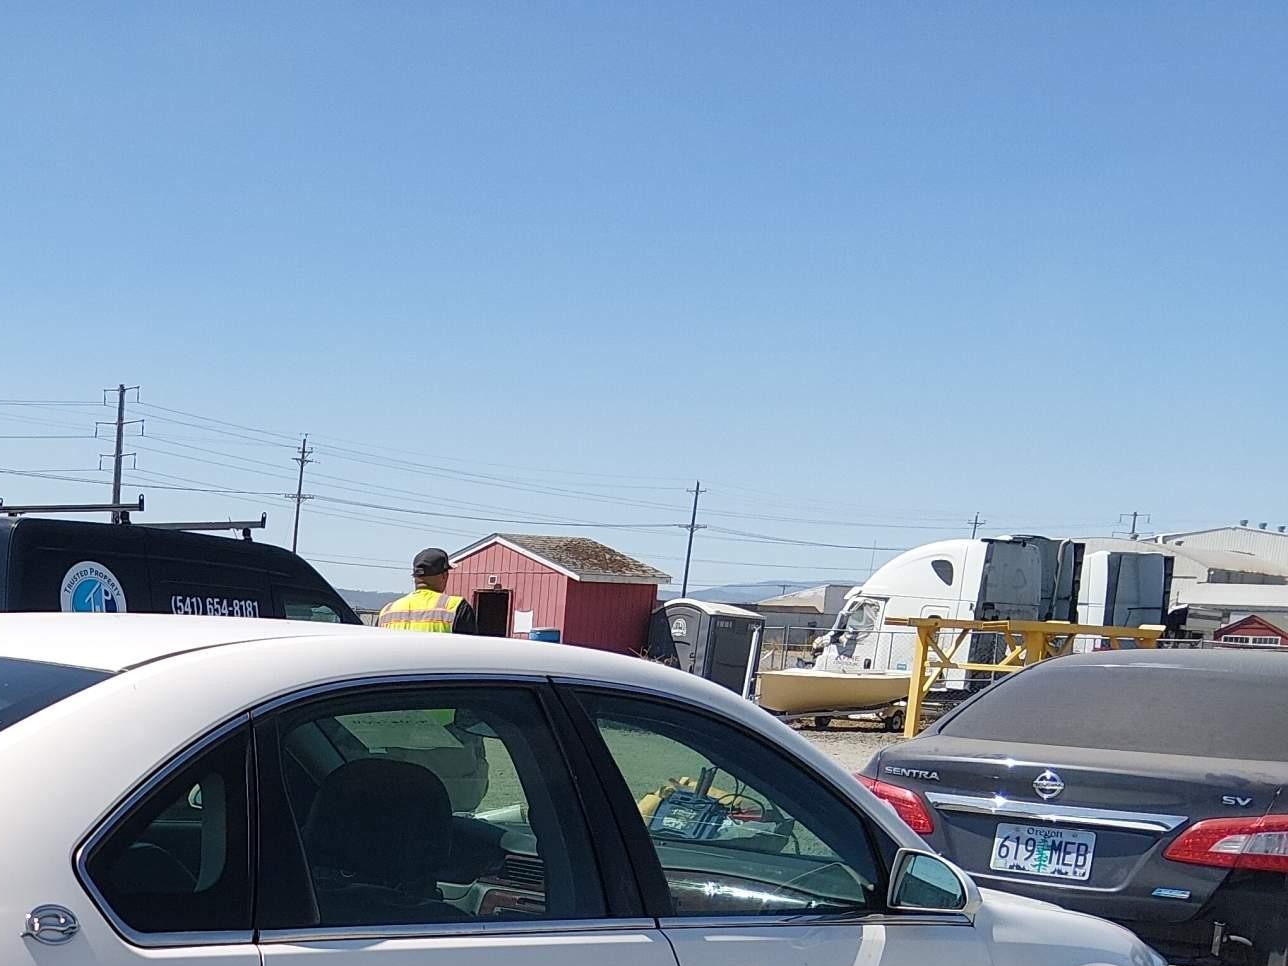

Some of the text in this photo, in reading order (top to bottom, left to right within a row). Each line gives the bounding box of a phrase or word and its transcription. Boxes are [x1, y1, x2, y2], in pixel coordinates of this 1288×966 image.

[64, 567, 121, 596] TRUSTED PROPERTY
[171, 595, 260, 618] (541) 654-8181
[884, 766, 940, 781] SENTRA
[1222, 795, 1252, 806] SV
[1027, 827, 1063, 839] Oregon
[997, 835, 1088, 868] 619 MEB
